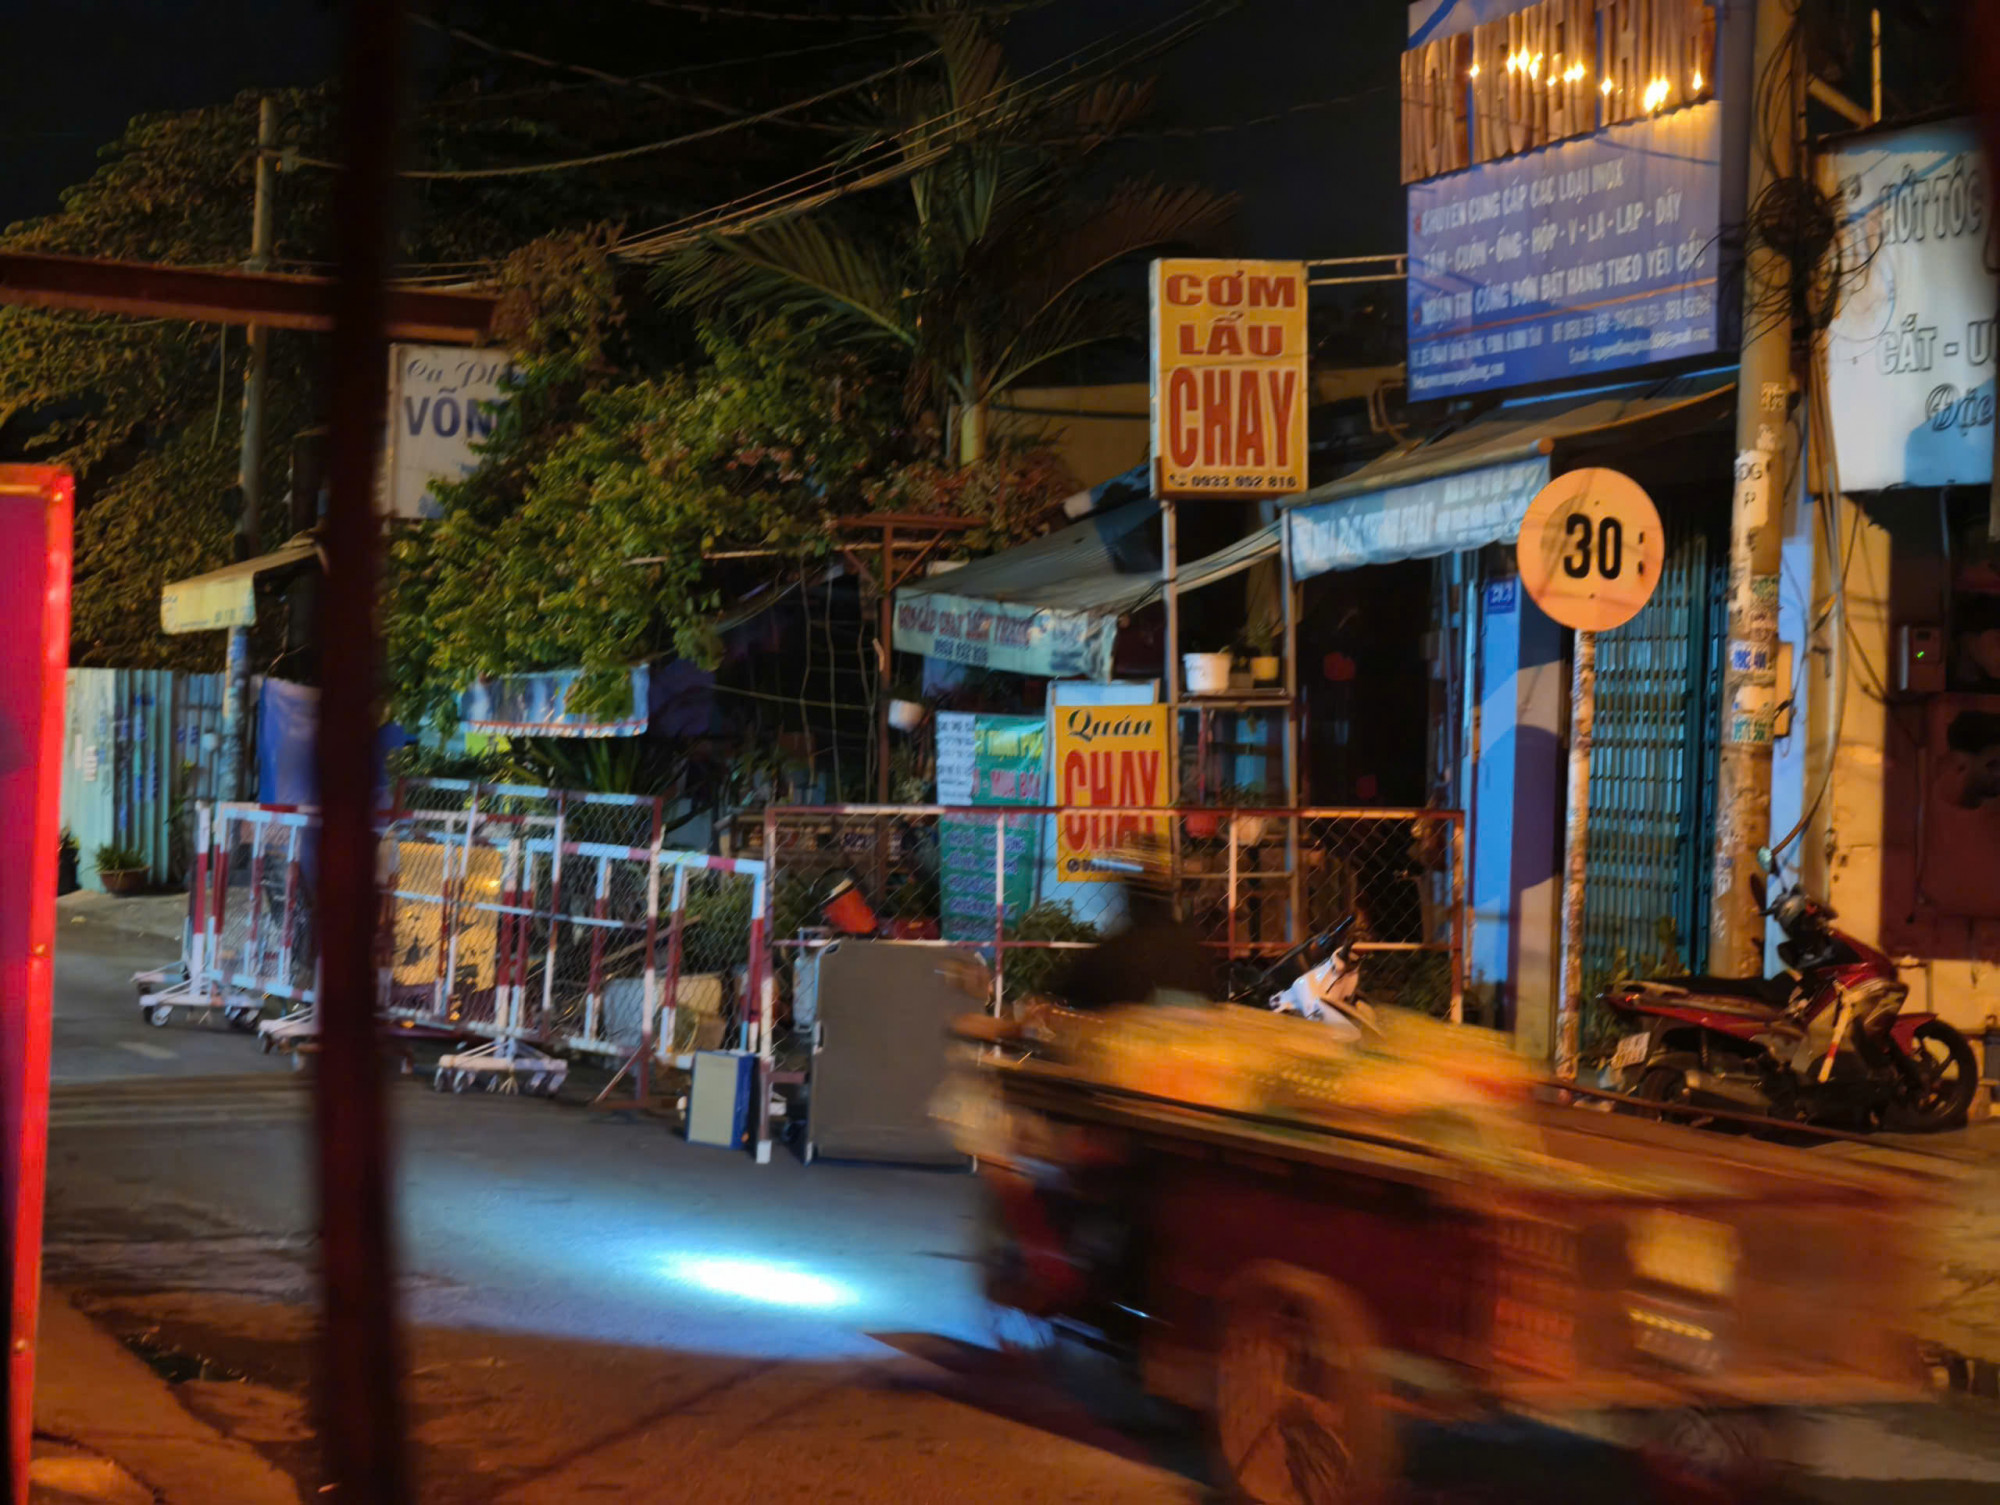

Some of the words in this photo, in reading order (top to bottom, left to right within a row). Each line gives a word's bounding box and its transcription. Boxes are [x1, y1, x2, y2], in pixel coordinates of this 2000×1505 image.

[1166, 270, 1296, 308] CƠM
[1606, 252, 1643, 288] THEO
[1169, 366, 1297, 468] CHAY
[1563, 513, 1623, 580] 30
[1067, 708, 1153, 743] Quán
[1064, 750, 1160, 852] CHAY
